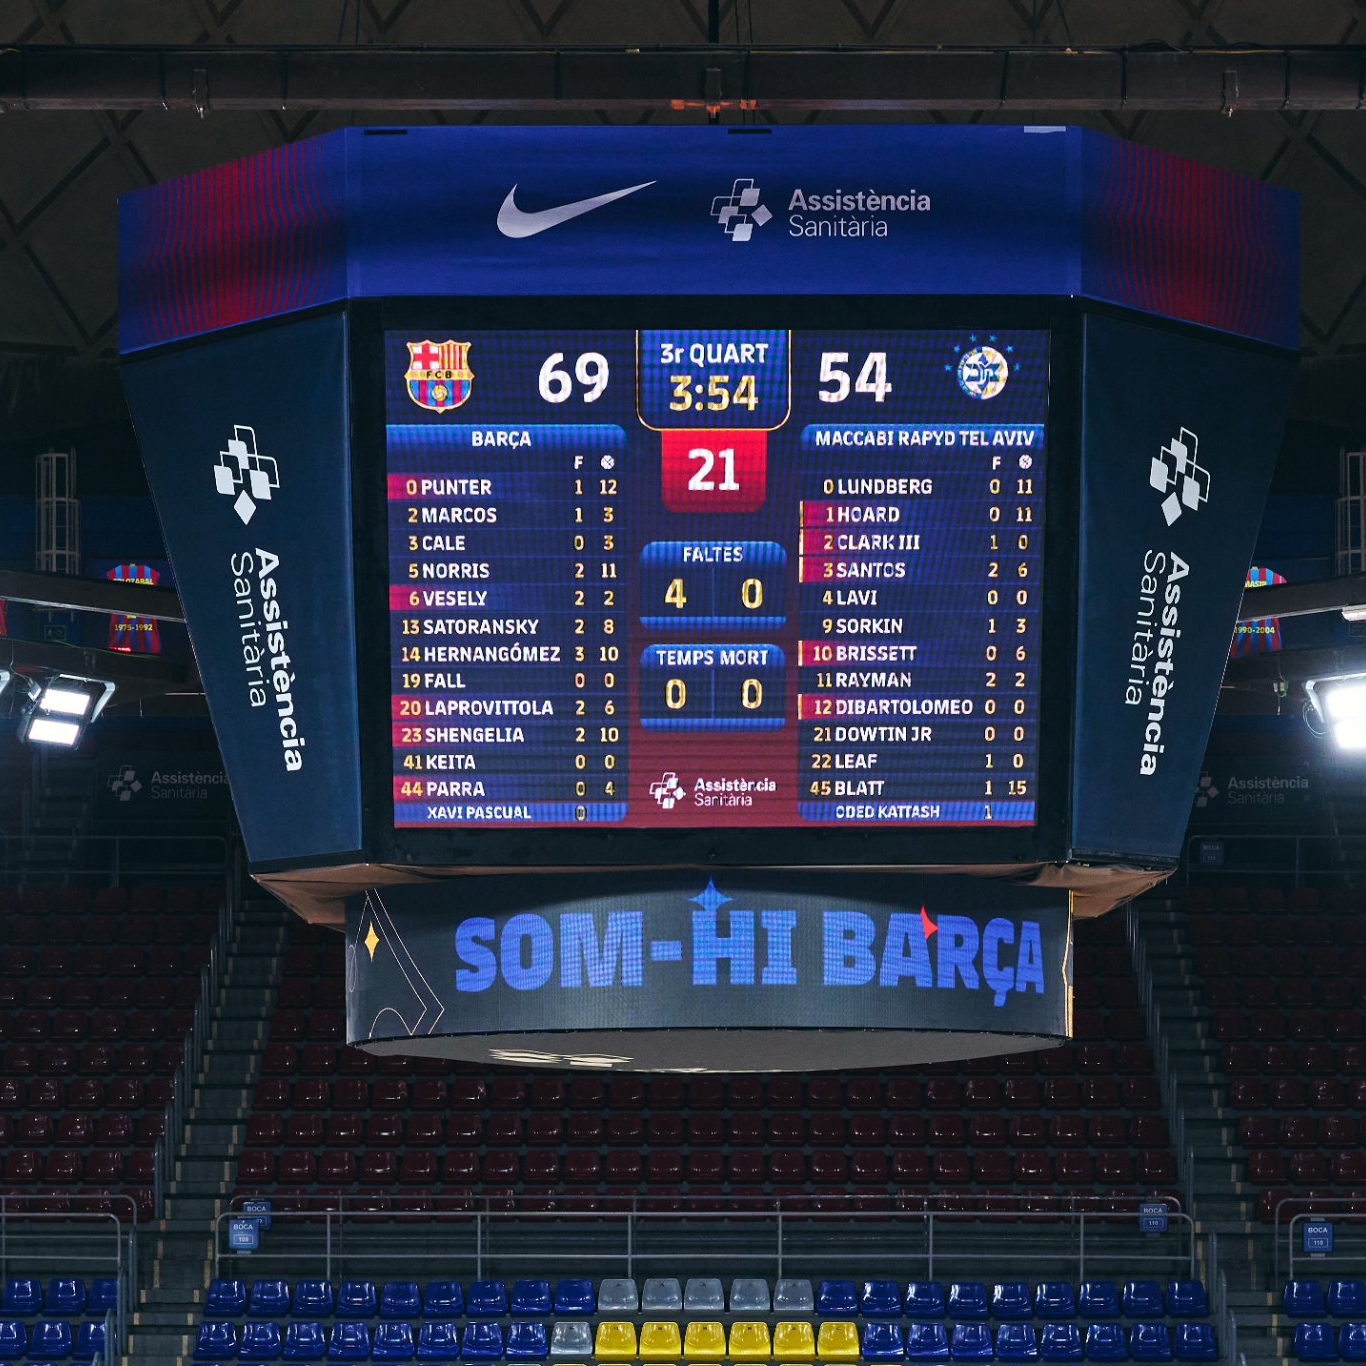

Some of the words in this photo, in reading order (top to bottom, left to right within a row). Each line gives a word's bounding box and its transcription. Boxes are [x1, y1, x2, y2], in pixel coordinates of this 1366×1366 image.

[788, 189, 931, 211] Assistència
[789, 214, 887, 237] Sanitària
[661, 344, 684, 363] 3r
[689, 343, 769, 364] QUART
[539, 352, 609, 403] 69
[819, 352, 892, 402] 54
[669, 375, 759, 412] 3:54
[472, 431, 531, 449] BARÇA
[816, 431, 893, 446] MACCABI
[899, 431, 955, 446] RAPYD
[959, 431, 989, 445] TEL
[993, 431, 1034, 445] AVIV
[574, 456, 583, 469] F
[688, 449, 740, 491] 21
[992, 456, 1001, 469] F
[406, 481, 417, 494] 0
[422, 480, 491, 495] PUNTER
[600, 480, 617, 494] 12
[824, 480, 834, 494] 0
[838, 479, 932, 495] LUNDBERG
[1017, 479, 1032, 493] 11
[408, 508, 417, 523] 2
[422, 508, 496, 523] MARCOS
[827, 508, 833, 522] 1
[838, 507, 899, 522] HOARD
[1016, 508, 1032, 521] 11
[409, 536, 418, 550] 3
[422, 535, 465, 550] CALE
[824, 536, 833, 550] 2
[838, 535, 894, 550] CLARK
[899, 535, 920, 550] III
[683, 546, 743, 563] FALTES
[409, 564, 418, 578] 5
[422, 563, 490, 578] NORRIS
[602, 564, 616, 578] 11
[824, 563, 833, 577] 3
[837, 562, 906, 577] SANTOS
[409, 592, 420, 606] 6
[423, 591, 487, 606] VESELY
[665, 579, 686, 609] 4
[742, 579, 763, 609] 0
[823, 591, 833, 605] 4
[836, 590, 877, 605] LAVI
[231, 552, 270, 708] Sanitària
[402, 620, 420, 634] 13
[423, 619, 539, 635] SATORANSKY
[823, 619, 832, 633] 9
[836, 618, 903, 633] SORKIN
[1125, 550, 1166, 705] Sanitària
[401, 647, 420, 661] 14
[424, 642, 560, 662] HERNANGÓMEZ
[600, 647, 618, 661] 10
[657, 650, 713, 665] TEMPS
[720, 651, 768, 665] MORT
[813, 647, 832, 661] 10
[836, 646, 917, 661] BRISSETT
[255, 548, 305, 772] Assistència
[1140, 552, 1189, 776] Assistència
[402, 674, 420, 688] 19
[425, 673, 465, 688] FALL
[817, 674, 832, 687] 11
[836, 673, 911, 688] RAYMAN
[665, 679, 686, 709] 0
[742, 679, 763, 709] 0
[400, 701, 421, 715] 20
[425, 700, 553, 715] LAPROVITTOLA
[814, 701, 831, 715] 12
[836, 700, 973, 715] DIBARTOLOMEO
[402, 728, 422, 742] 23
[426, 727, 524, 742] SHENGELIA
[600, 728, 618, 742] 10
[814, 728, 831, 741] 21
[836, 727, 907, 742] DOWTIN
[911, 727, 931, 742] JR
[403, 755, 422, 769] 41
[426, 754, 475, 770] KEITA
[811, 755, 831, 768] 22
[836, 754, 877, 769] LEAF
[401, 783, 423, 796] 44
[427, 782, 485, 796] PARRA
[695, 776, 776, 792] Assistència
[810, 781, 831, 795] 45
[835, 781, 884, 796] BLATT
[1009, 781, 1026, 795] 15
[1228, 776, 1309, 789] Assistència
[694, 792, 752, 807] Sanitària
[427, 807, 462, 819] XAVI
[466, 806, 531, 819] PASCUAL
[836, 806, 874, 819] ODED
[878, 806, 939, 819] KATTASH
[454, 910, 798, 992] SOM-HI
[822, 913, 1045, 1007] BARÇA
